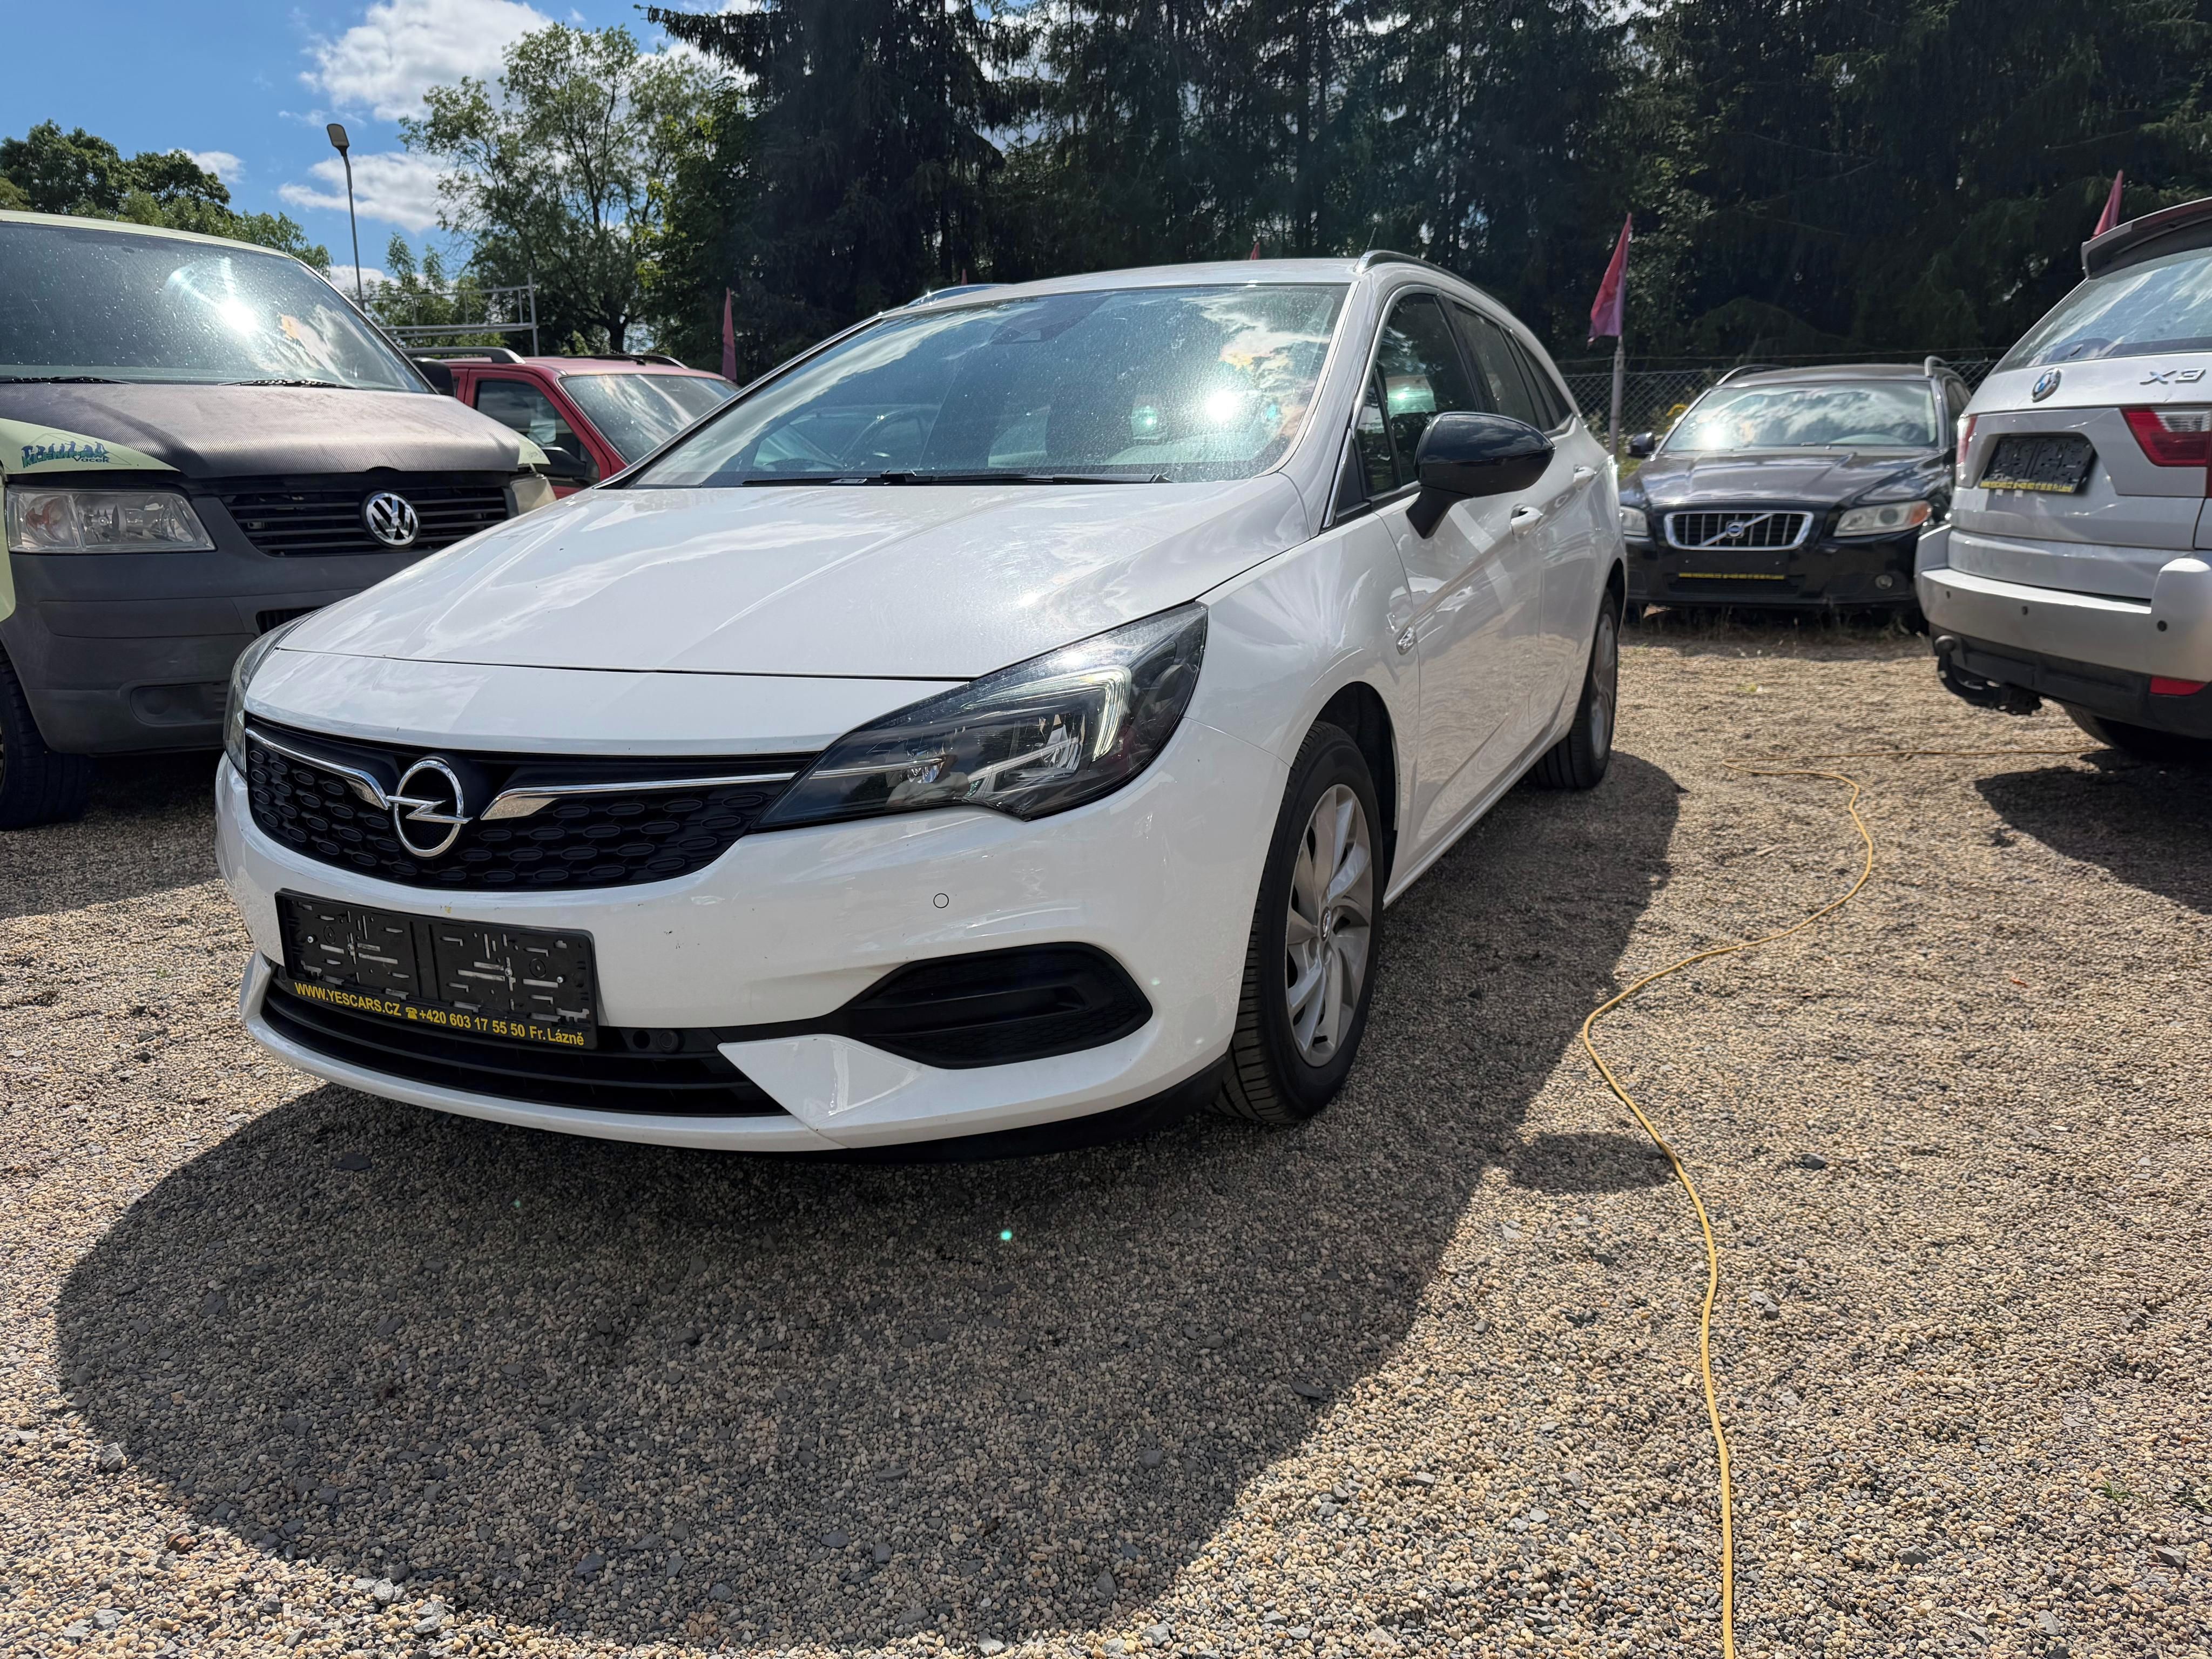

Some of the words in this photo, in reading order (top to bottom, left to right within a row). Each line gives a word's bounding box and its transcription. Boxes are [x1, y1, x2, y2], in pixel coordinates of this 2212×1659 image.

[2139, 368, 2206, 385] X3
[73, 455, 110, 463] Vacek
[295, 982, 401, 1016] WWW.YESCARS.CZ
[420, 1010, 447, 1024] +420
[449, 1014, 471, 1029] 603
[475, 1018, 488, 1031] 17
[492, 1020, 508, 1035] 55
[510, 1023, 526, 1037] 50
